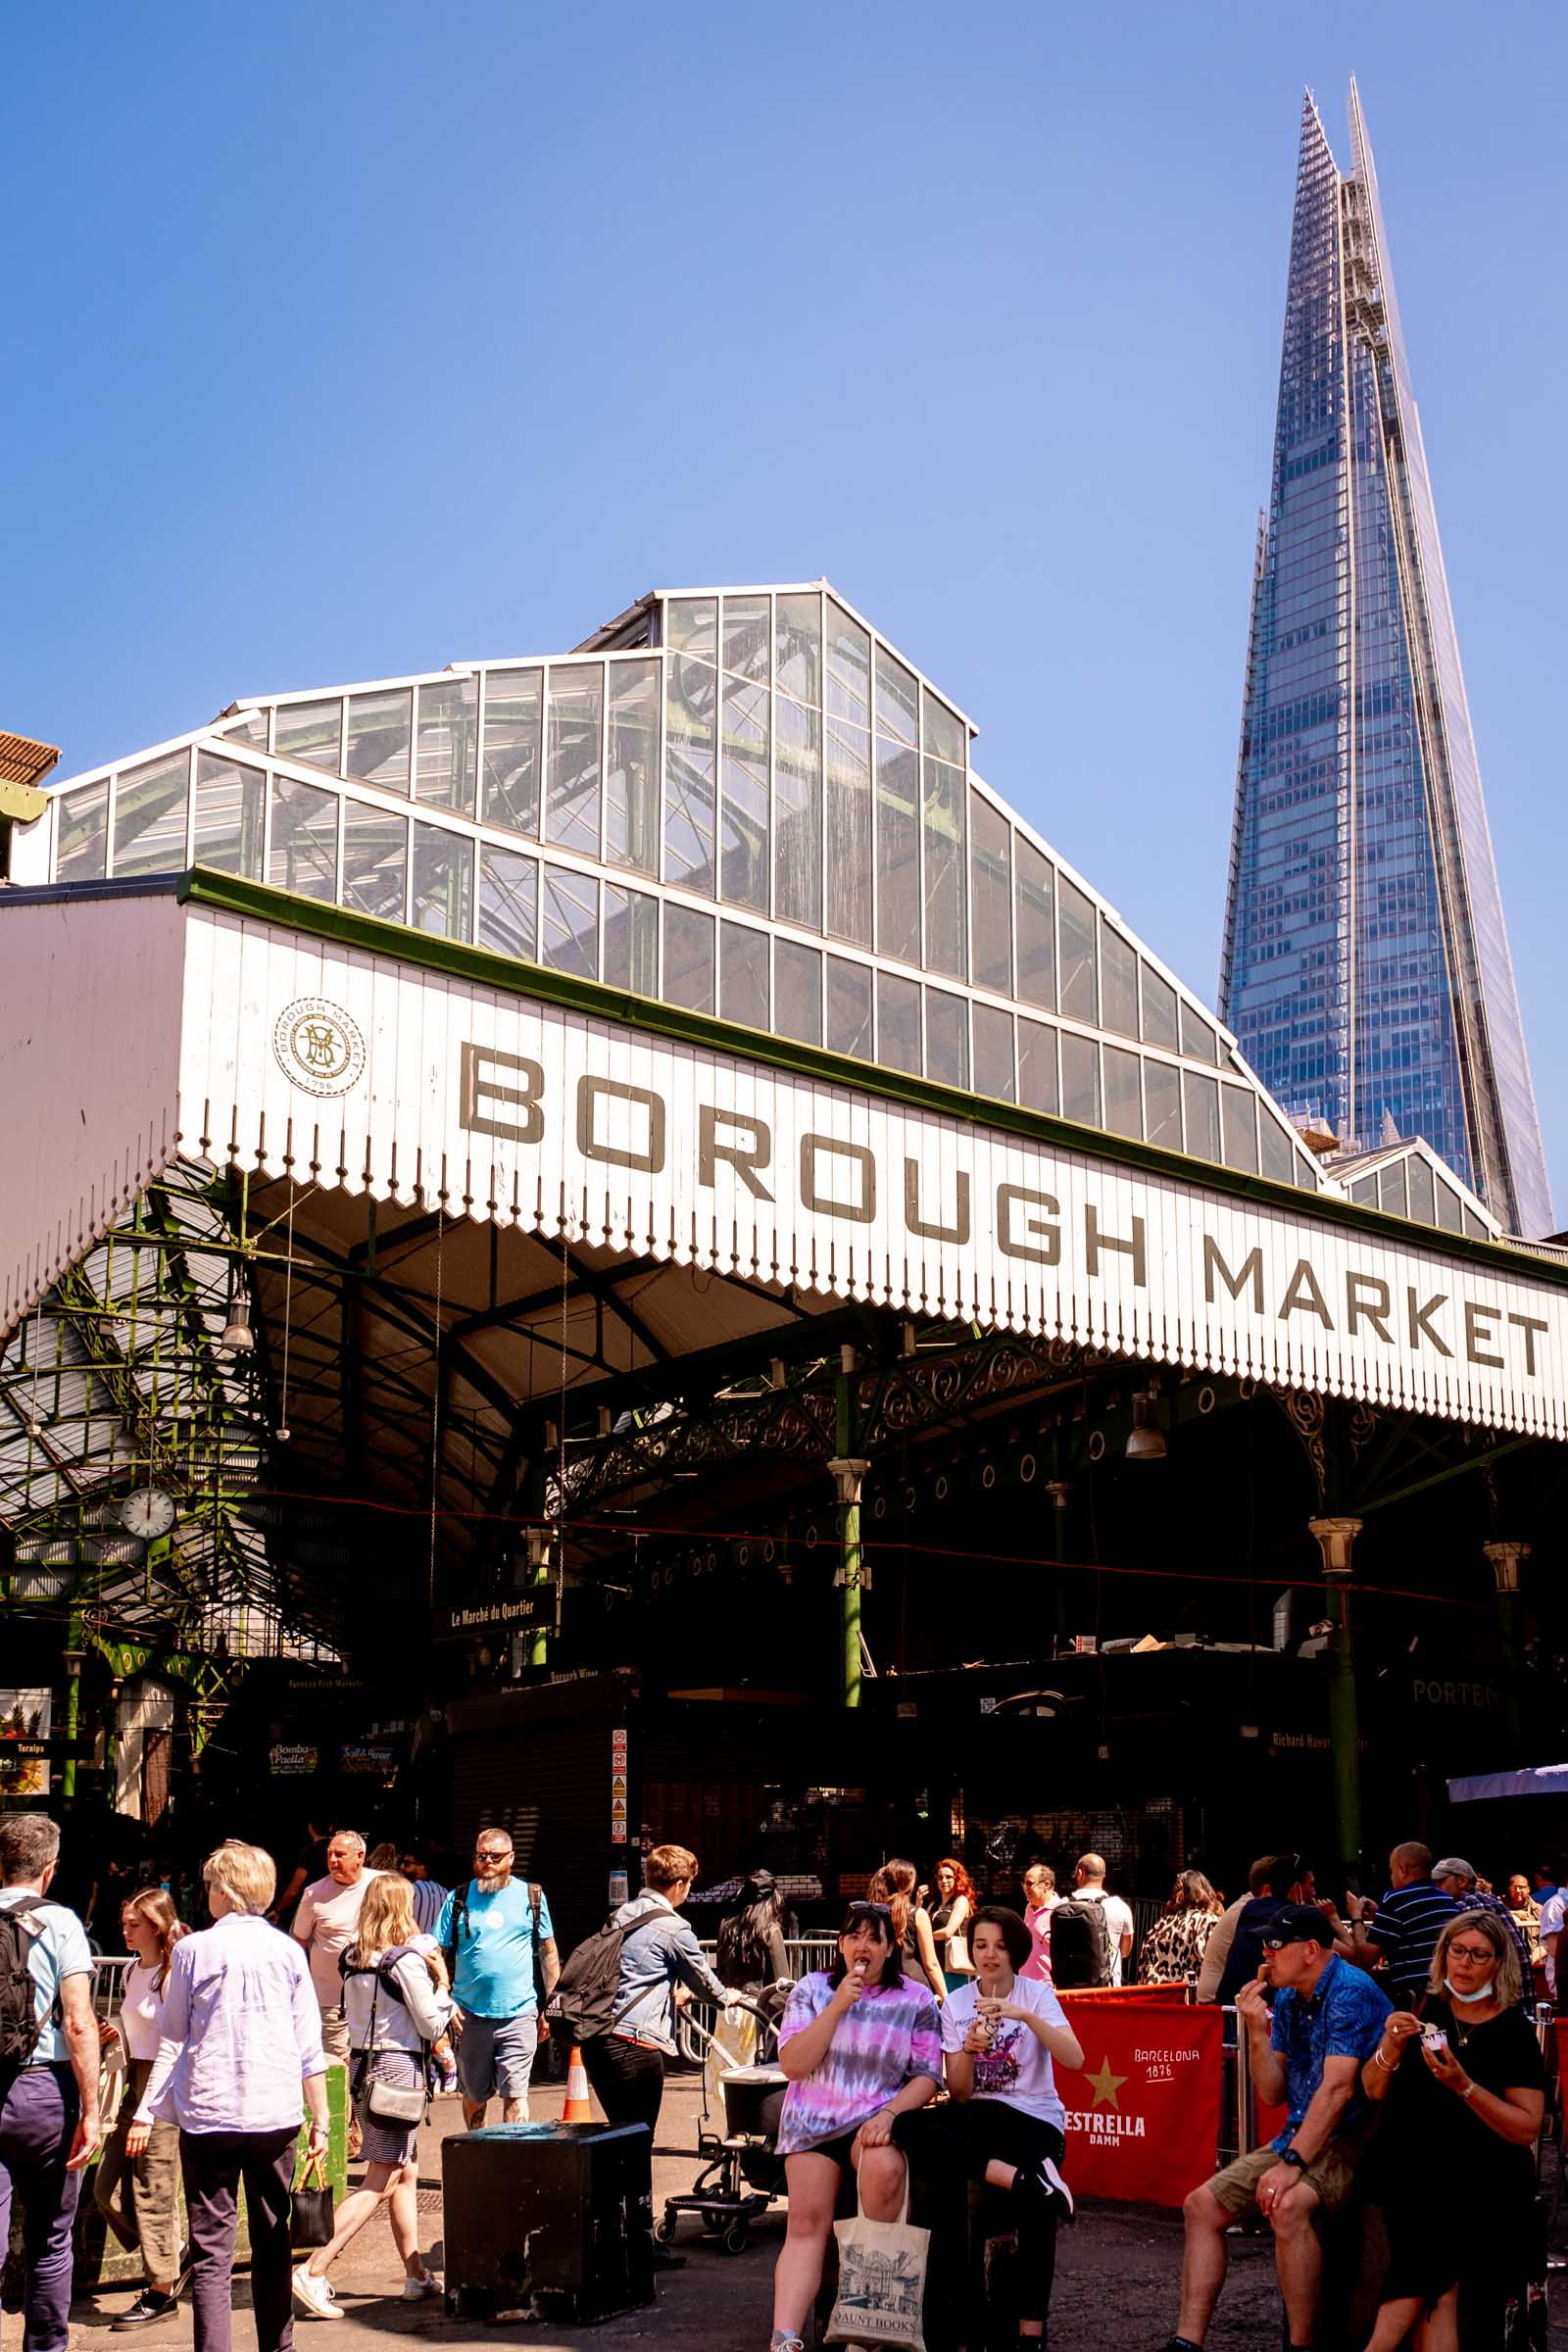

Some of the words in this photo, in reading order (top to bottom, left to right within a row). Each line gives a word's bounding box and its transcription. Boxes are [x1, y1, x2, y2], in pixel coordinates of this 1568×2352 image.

[279, 1003, 325, 1053] BOROUGH
[332, 1010, 361, 1070] MARKET
[459, 1041, 1147, 1288] BOROUGH
[1203, 1233, 1549, 1377] MARKET
[451, 1611, 461, 1628] Le
[462, 1606, 489, 1625] Marché
[490, 1604, 500, 1621] du
[502, 1599, 534, 1621] Quartier
[1272, 1732, 1305, 1747] Richard
[18, 1743, 45, 1754] Turnips
[275, 1742, 310, 1754] Bomba
[274, 1754, 305, 1765] Paella
[545, 2008, 563, 2017] adidas
[1134, 2048, 1200, 2063] BARCELONA
[1146, 2064, 1172, 2079] 1876
[1063, 2111, 1146, 2137] ESTRELLA
[1089, 2133, 1120, 2147] DAMM
[876, 2318, 917, 2331] BOOKS
